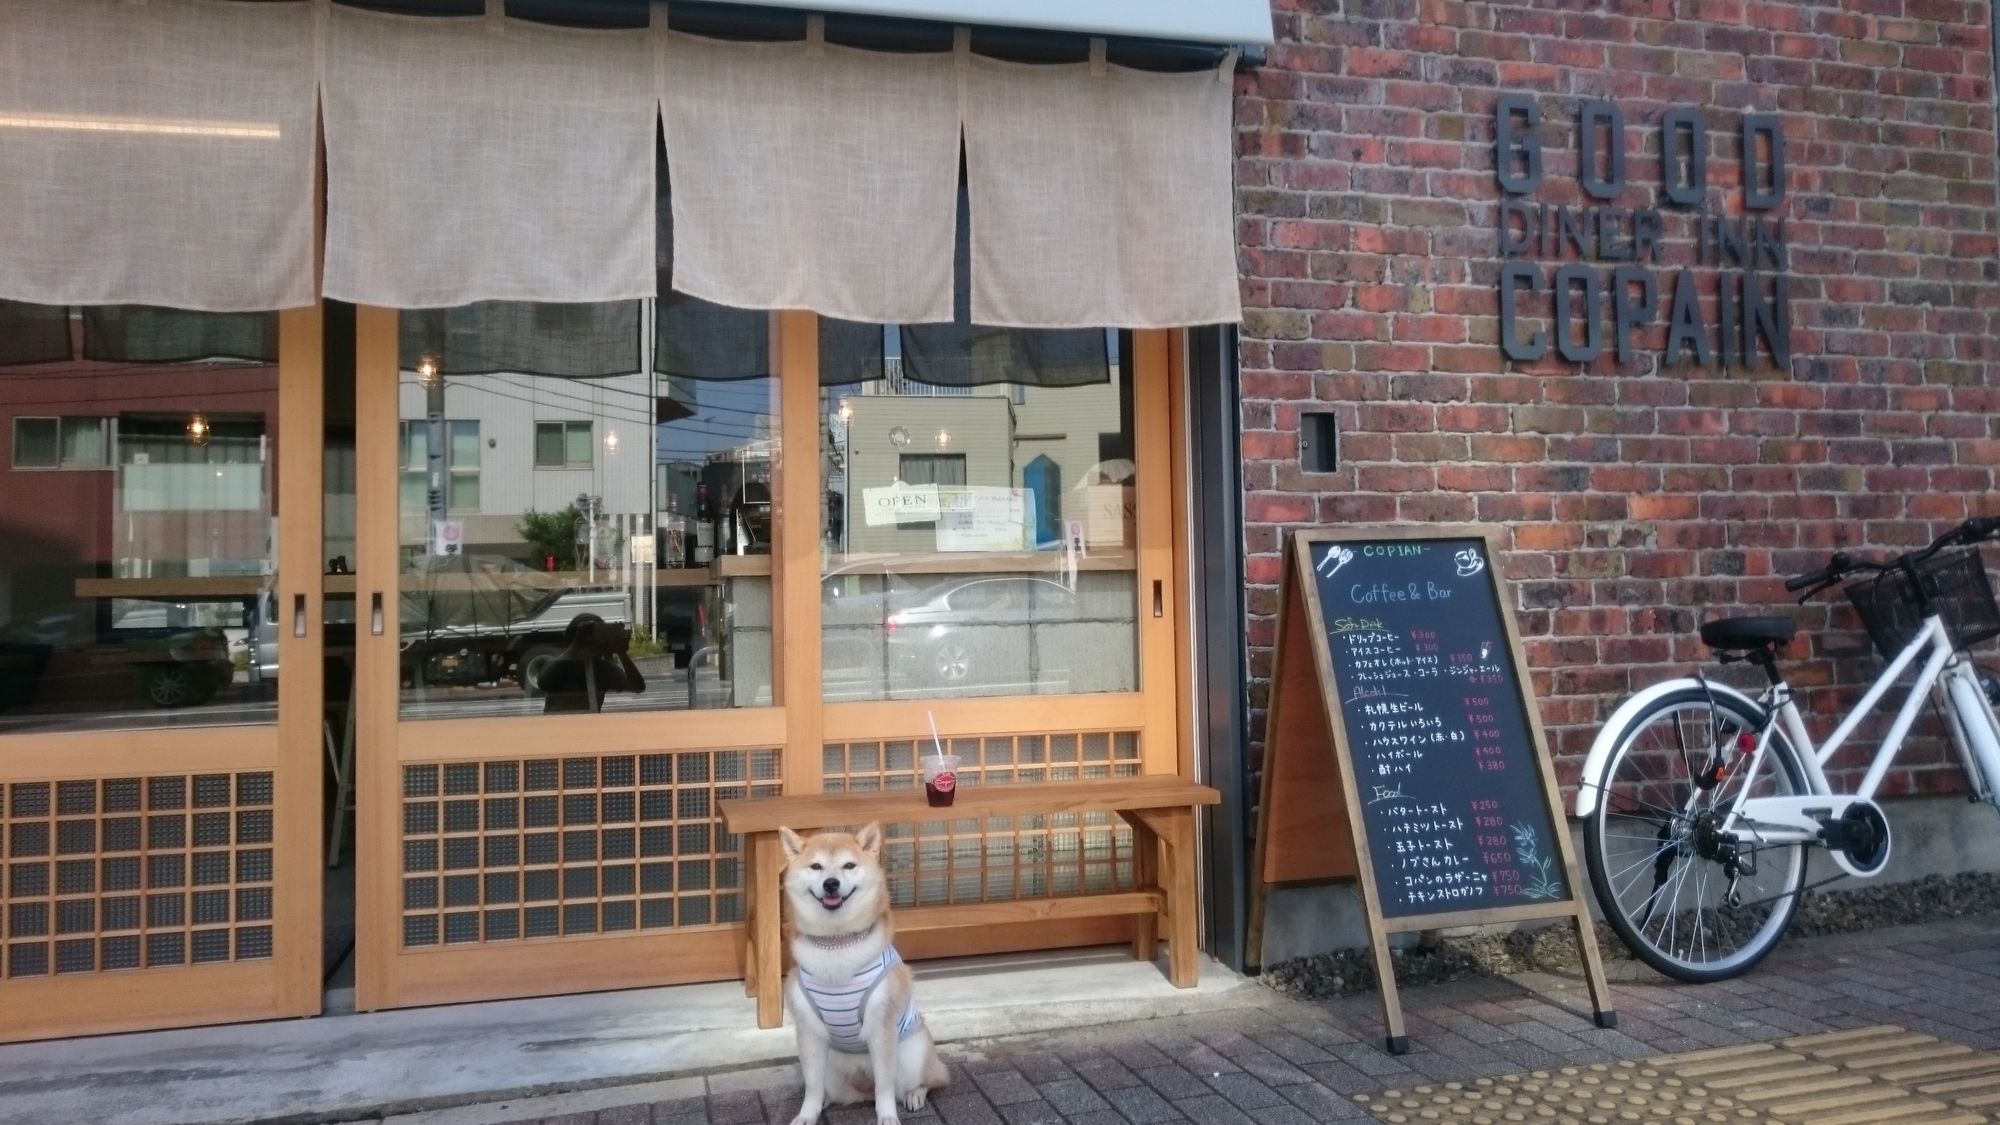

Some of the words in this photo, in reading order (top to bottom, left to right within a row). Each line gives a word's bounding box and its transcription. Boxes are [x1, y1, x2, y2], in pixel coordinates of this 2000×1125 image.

[1497, 94, 1786, 209] GOOD
[1500, 202, 1663, 261] DINER
[1699, 214, 1787, 270] INN
[1501, 262, 1790, 369] COPAIN
[878, 494, 927, 507] OPEN
[1427, 581, 1452, 600] Bar
[1348, 632, 1400, 645] ドリップコーヒー
[1350, 646, 1401, 656] アイスコーヒー
[1376, 749, 1423, 760] ハイボール
[1378, 764, 1412, 775] 酎ハイ
[1371, 782, 1402, 801] Food
[1388, 802, 1447, 816] バタートースト
[1471, 800, 1498, 810] ¥250
[1392, 817, 1464, 834] ハチミツトースト
[1474, 816, 1503, 827] ¥280
[1396, 837, 1454, 853] 玉子トースト
[1477, 835, 1507, 846] ¥280
[1482, 852, 1511, 864] ¥650
[1404, 871, 1488, 887] コパンのラザーニャ
[1408, 886, 1483, 904] チキンストロガノフ
